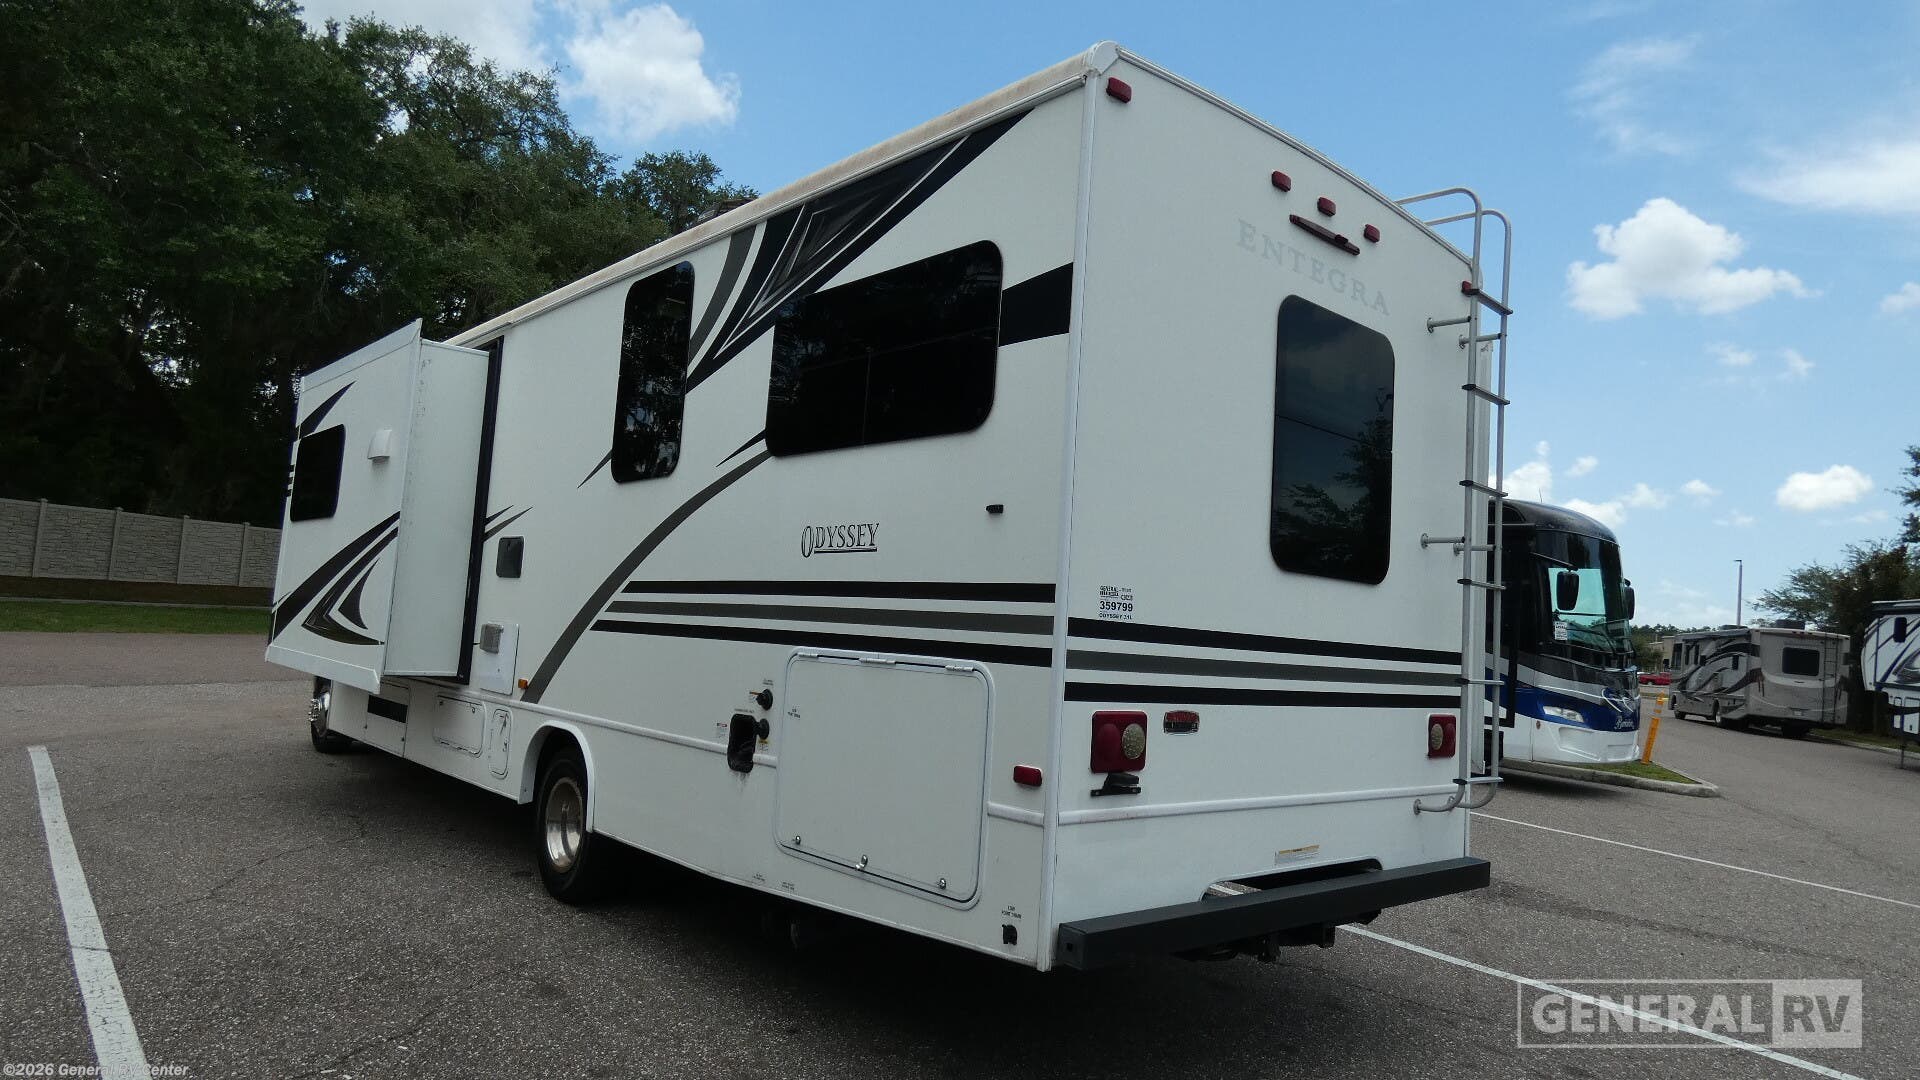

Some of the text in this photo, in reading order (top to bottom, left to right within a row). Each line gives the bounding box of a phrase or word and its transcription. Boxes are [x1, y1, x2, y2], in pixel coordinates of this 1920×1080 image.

[1237, 219, 1390, 317] ENTEGRA
[801, 522, 879, 558] ODYSSEY
[1099, 600, 1133, 612] 359799
